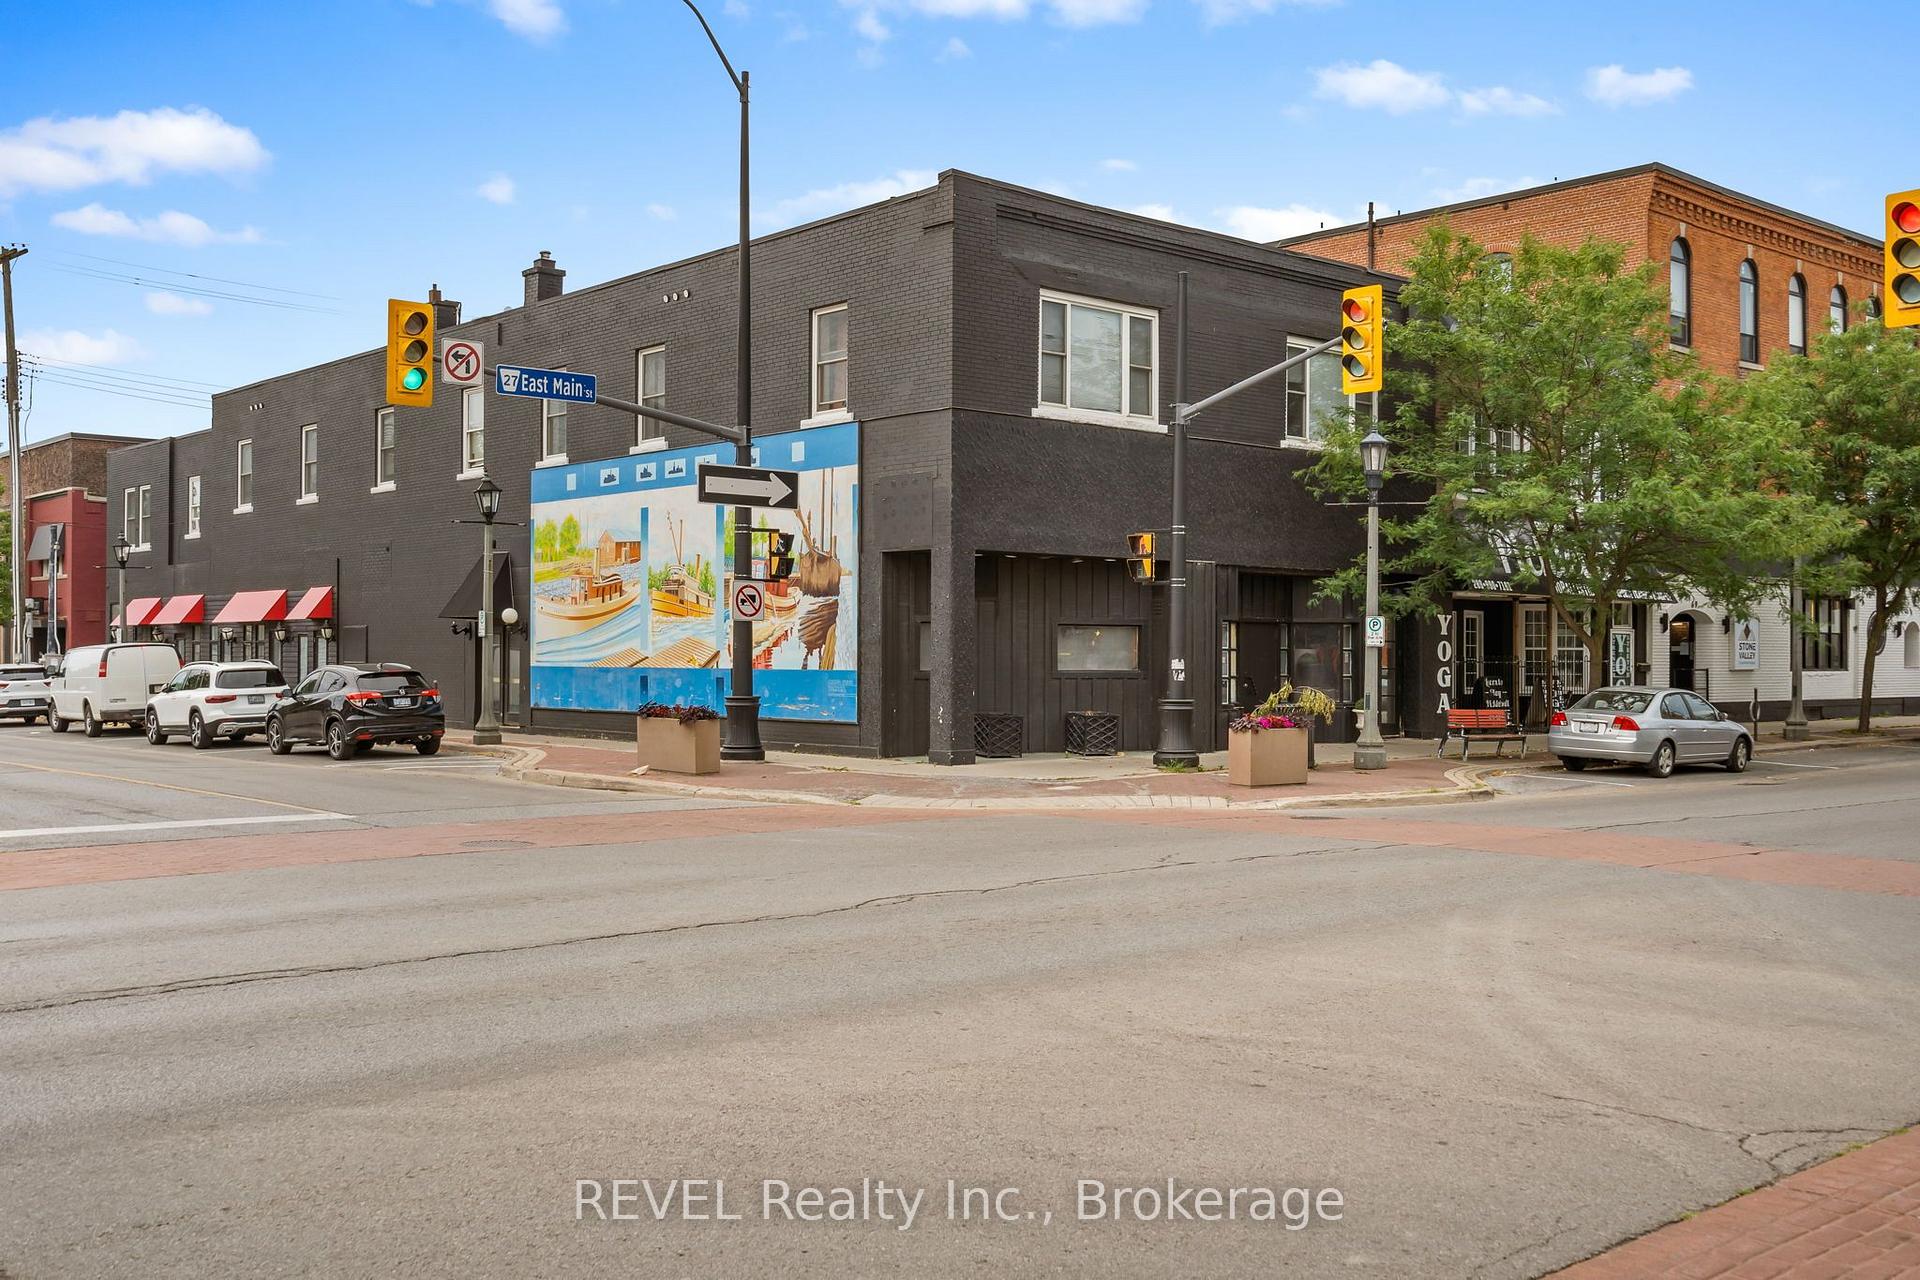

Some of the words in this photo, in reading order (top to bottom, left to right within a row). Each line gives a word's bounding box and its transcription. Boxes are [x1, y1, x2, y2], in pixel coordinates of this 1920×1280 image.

[504, 374, 518, 387] 27
[521, 374, 548, 393] East
[553, 377, 583, 397] Main
[1738, 642, 1757, 651] STONE
[1436, 614, 1452, 714] YOGA
[1738, 652, 1756, 660] VALLEY
